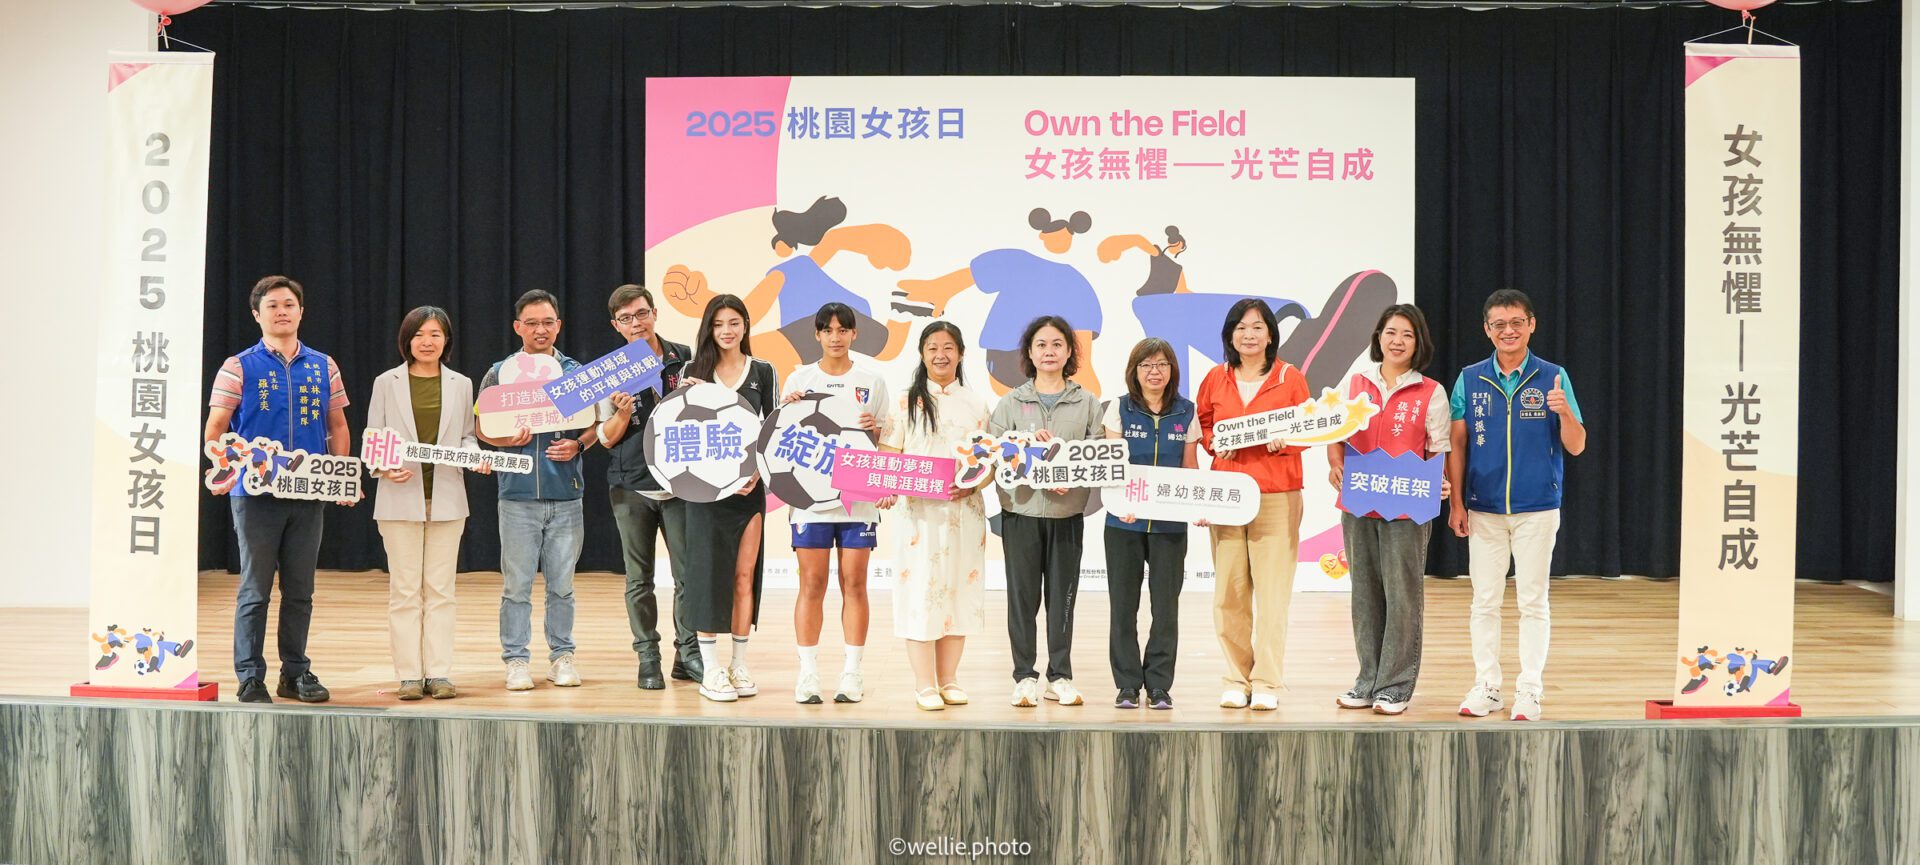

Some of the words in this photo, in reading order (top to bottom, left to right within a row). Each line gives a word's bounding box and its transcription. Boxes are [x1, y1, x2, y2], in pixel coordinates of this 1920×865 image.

[687, 110, 776, 138] 2025
[787, 106, 964, 140] 桃園女孩日
[1025, 109, 1100, 137] Own
[1109, 109, 1164, 137] the
[1172, 109, 1246, 137] Field
[140, 132, 171, 310] 2025
[549, 351, 630, 400] 女孩運動場域
[579, 354, 659, 403] 的平權與挑戰
[501, 389, 552, 407] 打造婦
[1217, 422, 1244, 433] Own
[1247, 417, 1266, 428] the
[1268, 409, 1295, 423] Field
[128, 331, 170, 554] 桃園女孩日
[664, 422, 743, 463] 體驗
[1069, 444, 1124, 461] 2025
[310, 459, 357, 477] 2025
[406, 445, 530, 471] 桃園市政府婦幼發展局
[841, 452, 934, 474] 女孩運動夢想
[867, 472, 945, 494] 與職涯選擇
[1032, 463, 1125, 484] 桃園女孩日
[1350, 471, 1431, 498] 突破框架
[277, 475, 357, 498] 桃園女孩日
[1156, 483, 1241, 503] 婦幼發展局
